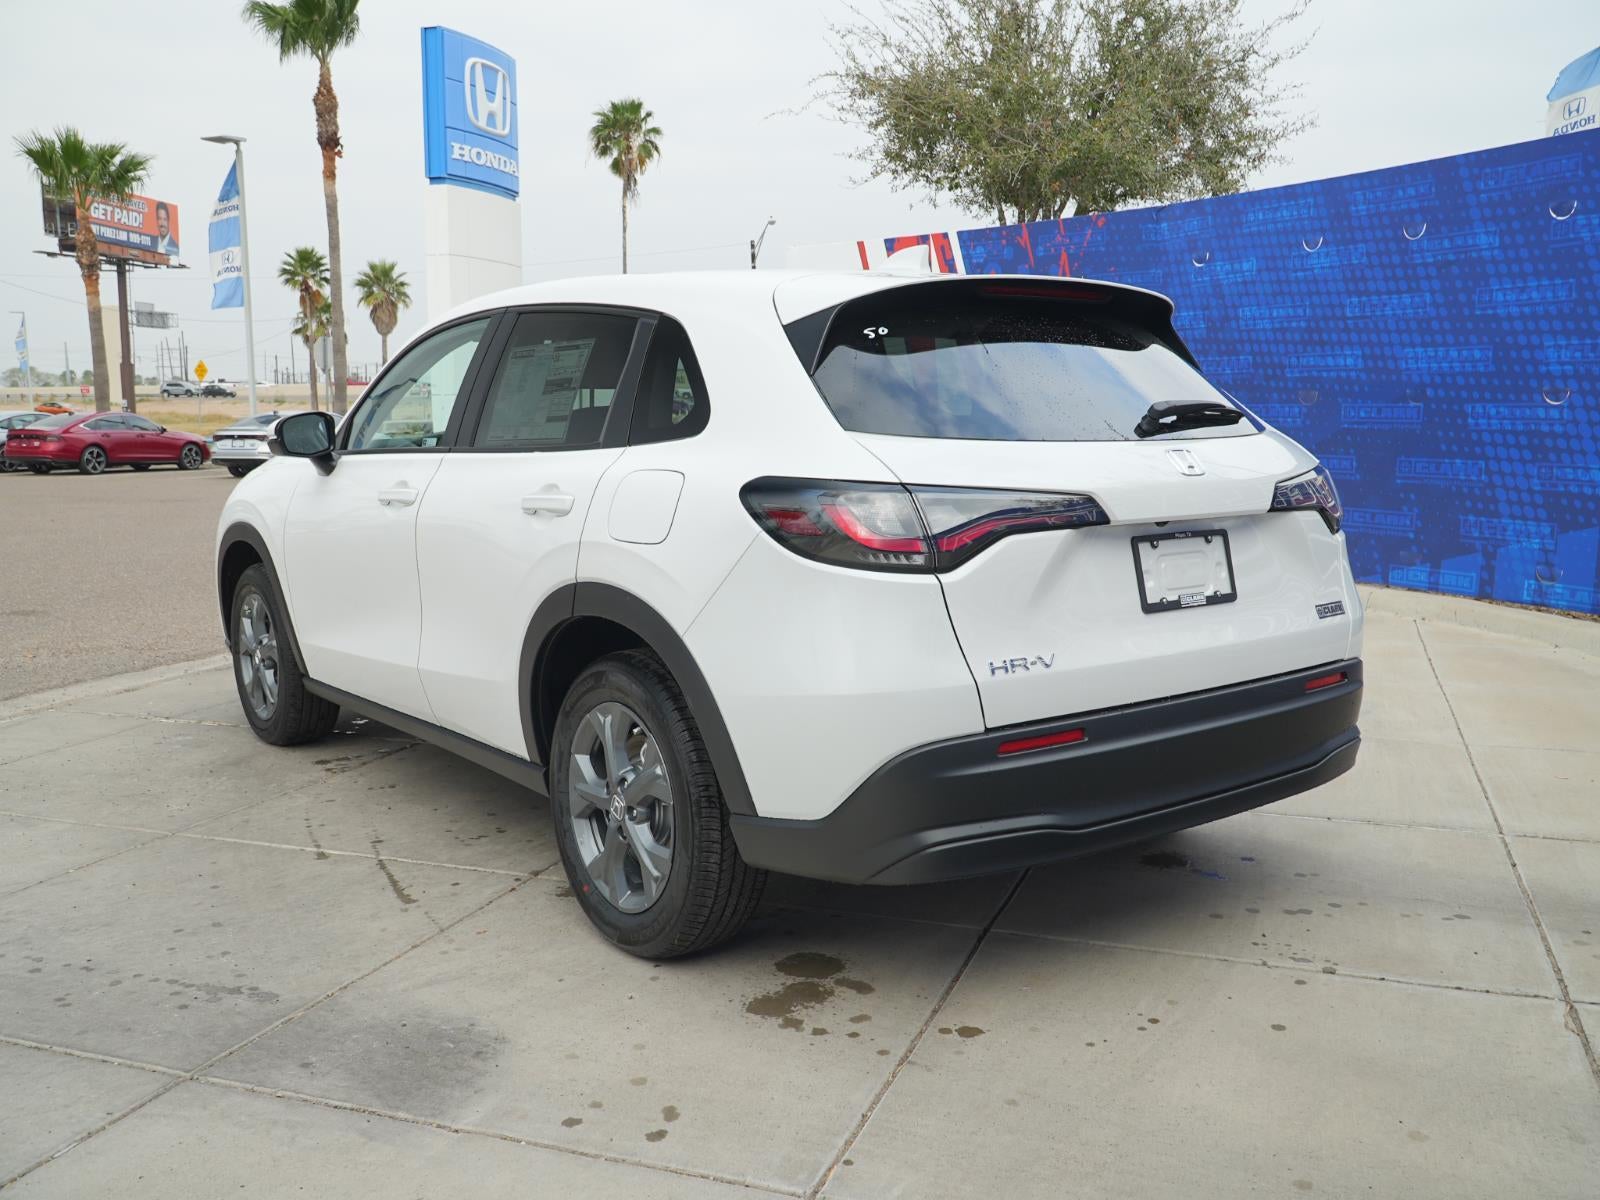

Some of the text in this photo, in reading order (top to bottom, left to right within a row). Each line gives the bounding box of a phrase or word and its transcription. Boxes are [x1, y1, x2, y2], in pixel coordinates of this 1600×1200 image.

[450, 142, 519, 176] HONDA
[91, 202, 113, 221] GET
[114, 207, 143, 228] PAID!
[989, 652, 1055, 676] HR-V
